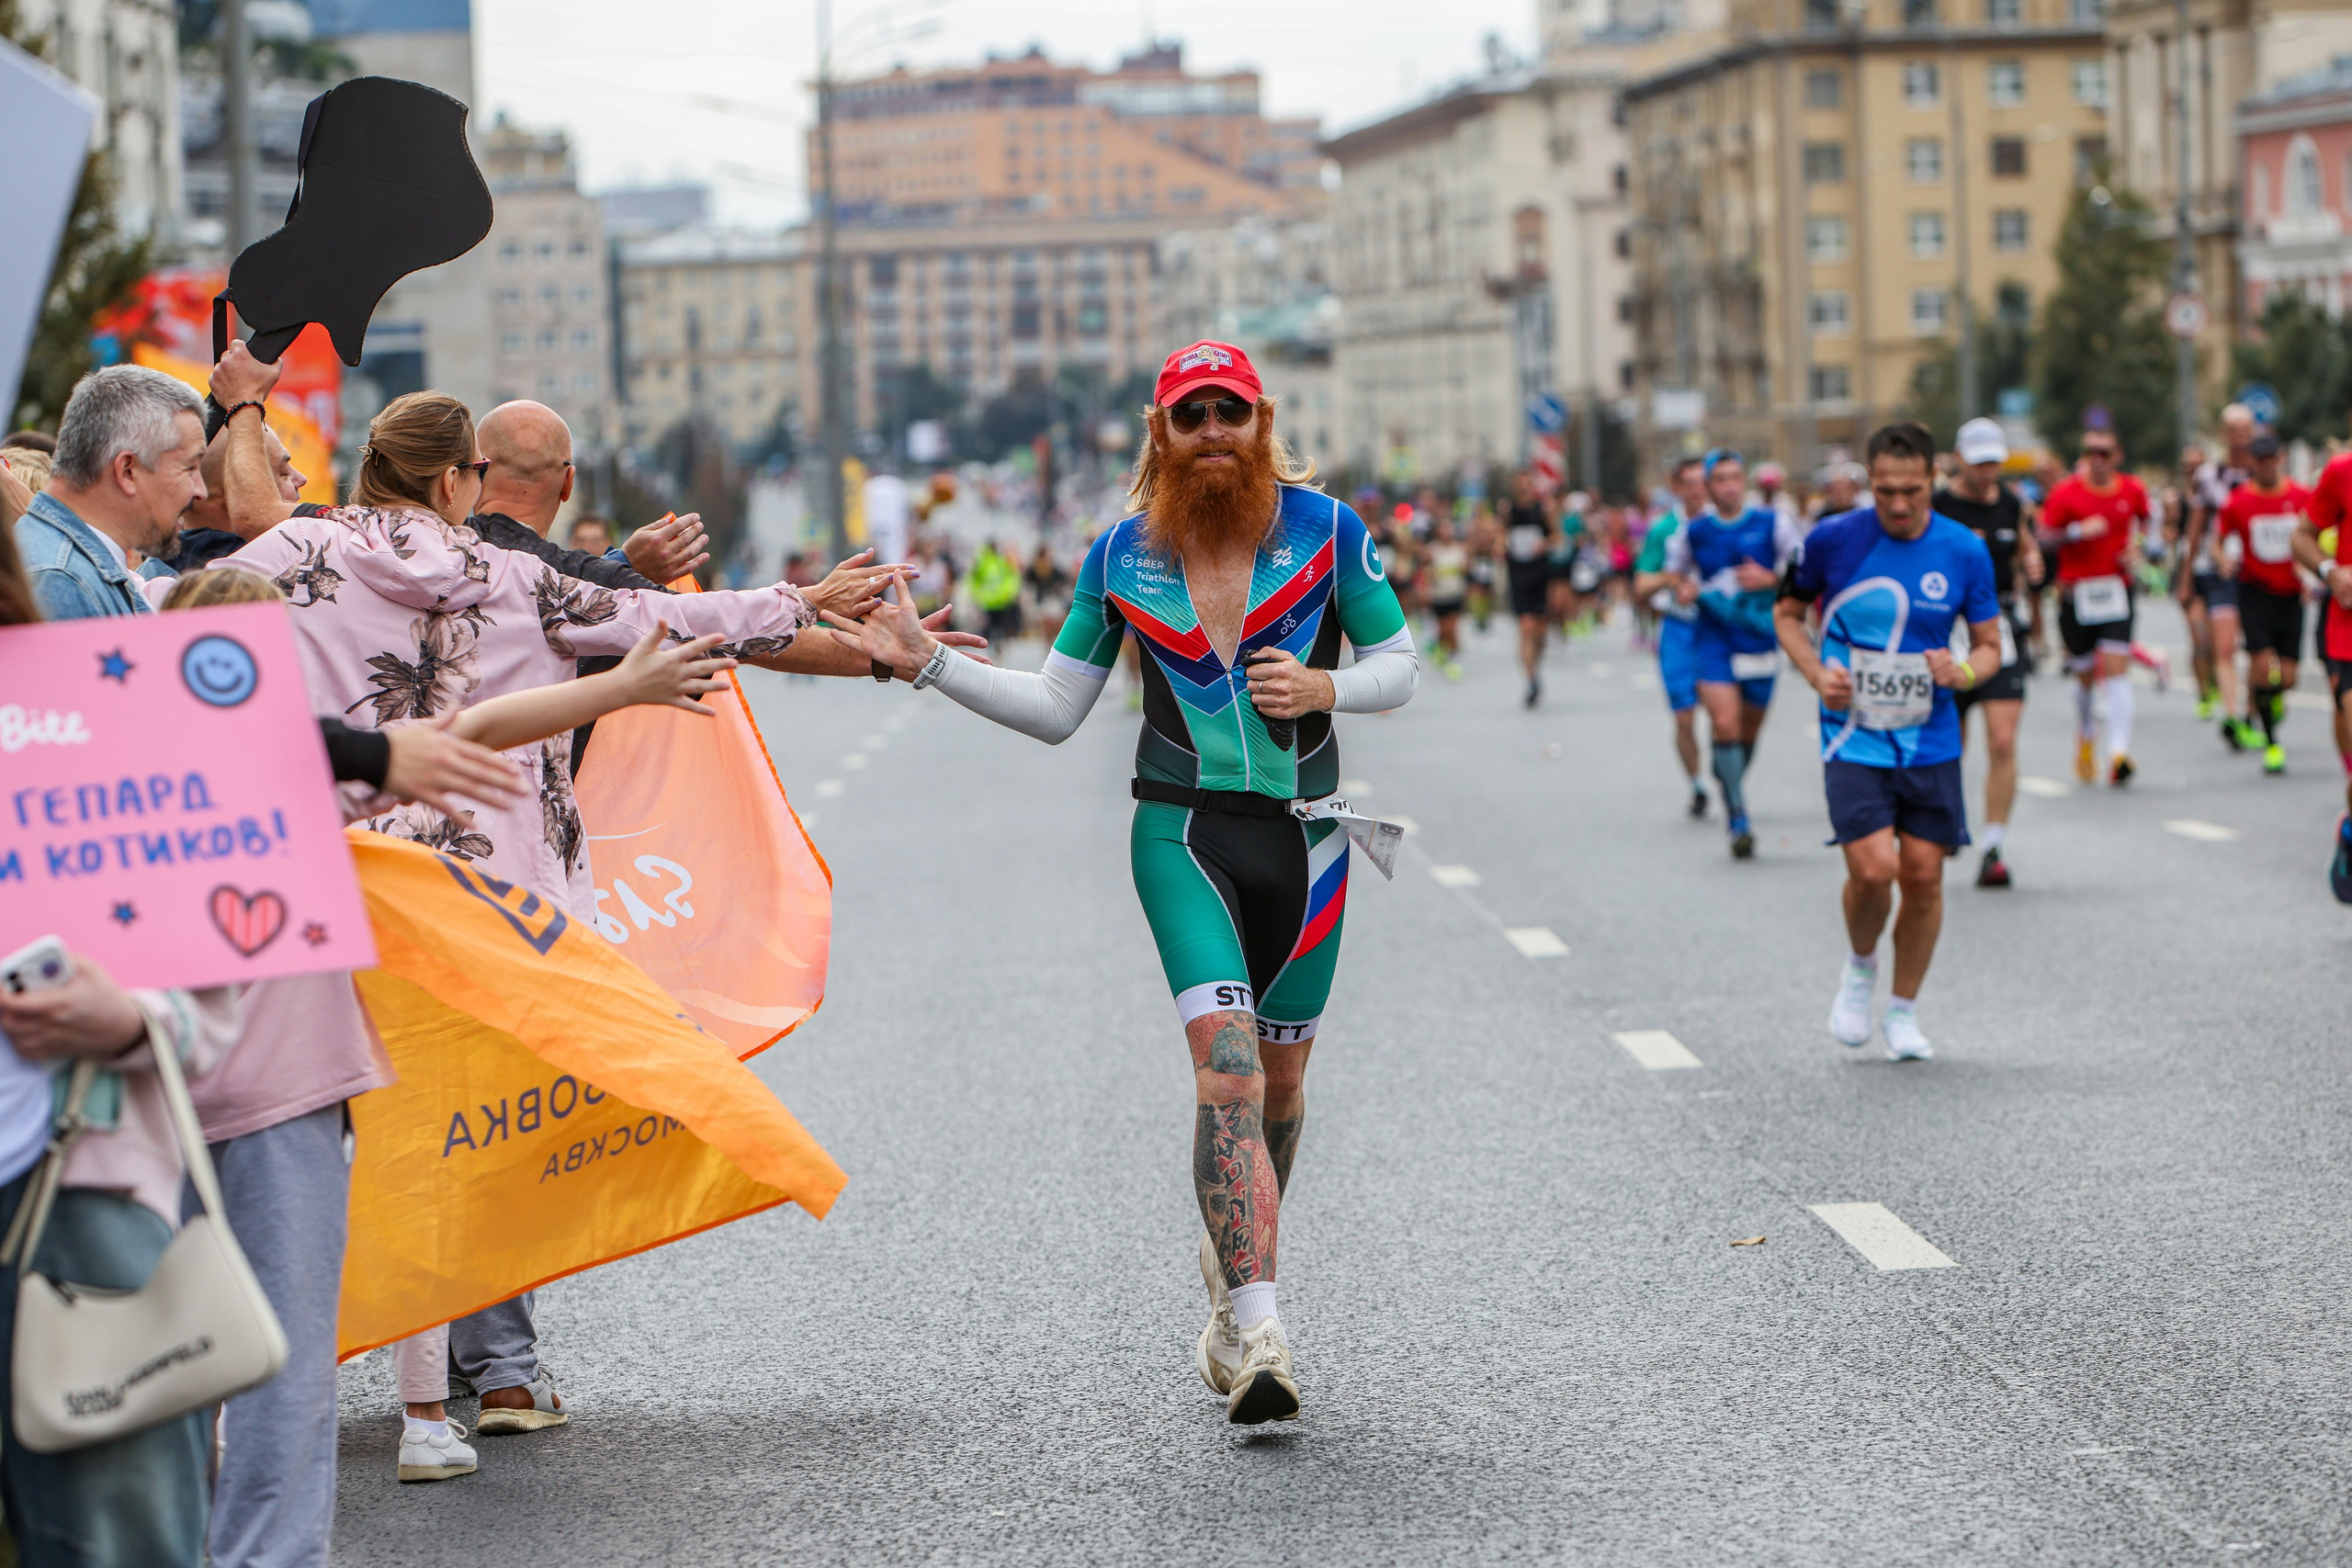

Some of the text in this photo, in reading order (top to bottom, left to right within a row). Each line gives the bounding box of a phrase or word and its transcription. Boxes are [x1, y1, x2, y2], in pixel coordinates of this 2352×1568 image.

[1136, 558, 1164, 570] SBER
[1135, 571, 1180, 585] Triathlon
[1136, 584, 1163, 594] Team
[1855, 670, 1929, 698] 15695
[13, 773, 219, 826] ГЕПАРД
[44, 808, 290, 877] КОТИКОВ!
[1216, 986, 1253, 1010] STT
[1256, 1019, 1309, 1040] STT
